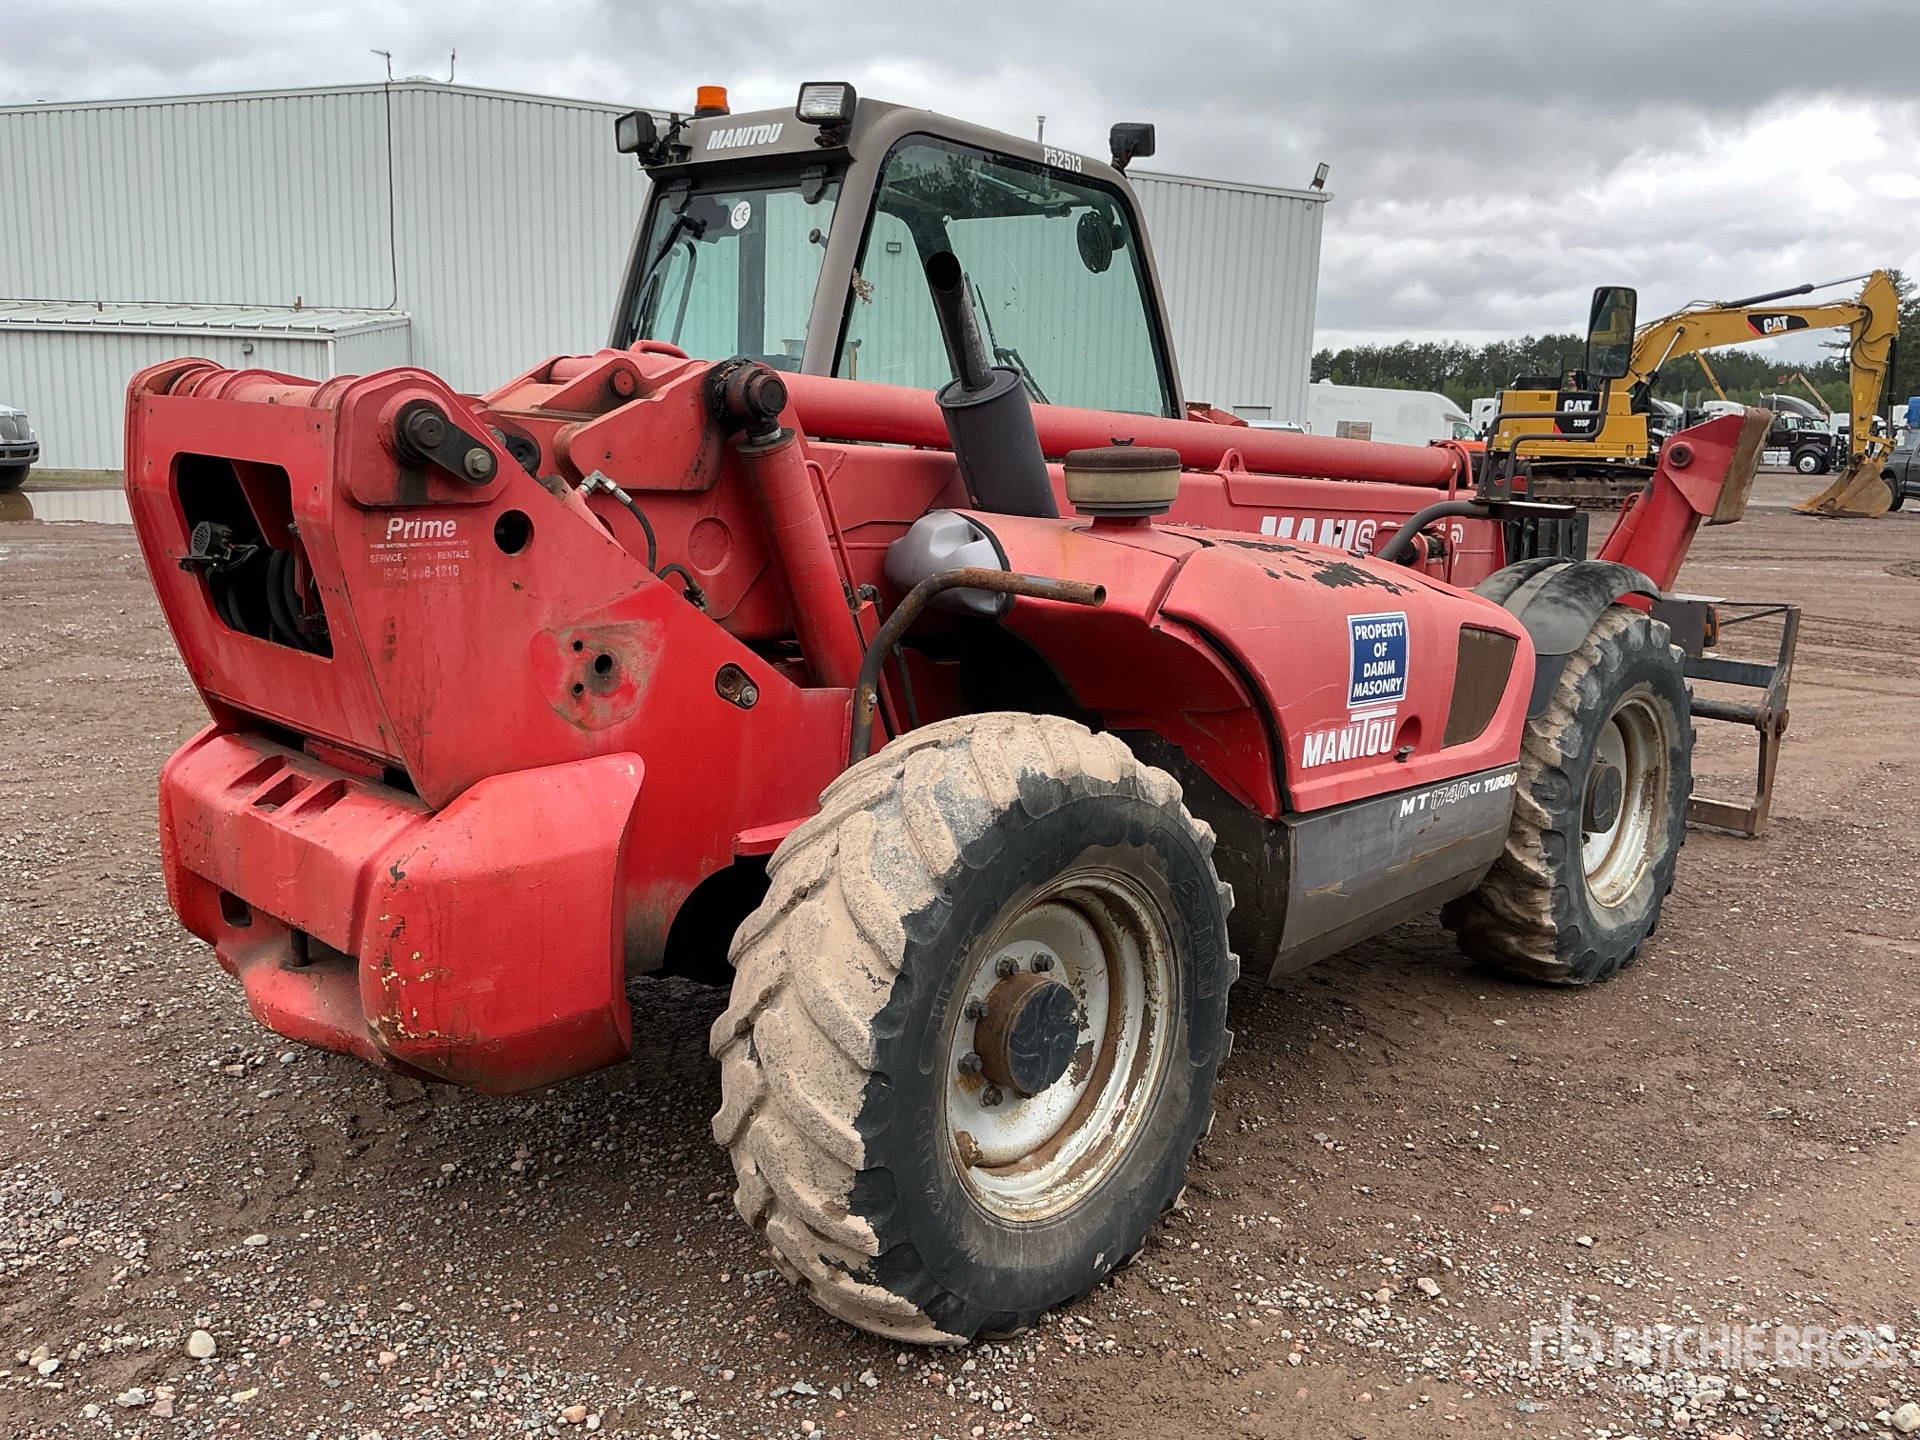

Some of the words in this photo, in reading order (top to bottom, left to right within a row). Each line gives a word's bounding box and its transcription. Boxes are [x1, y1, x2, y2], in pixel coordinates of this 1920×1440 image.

[706, 122, 784, 151] MANITOU
[1043, 146, 1082, 173] P52513
[1763, 315, 1788, 334] CAT
[1563, 399, 1592, 412] CAT
[386, 516, 457, 540] Prime
[369, 553, 402, 563] SERVICE
[437, 550, 470, 560] RENTALS
[1354, 622, 1404, 641] PROPERTY
[1373, 642, 1388, 658] OF
[1363, 659, 1396, 678] DARIM
[1352, 677, 1403, 698] MASONRY
[1301, 707, 1398, 768] MANITOU
[1484, 771, 1518, 793] TURBO
